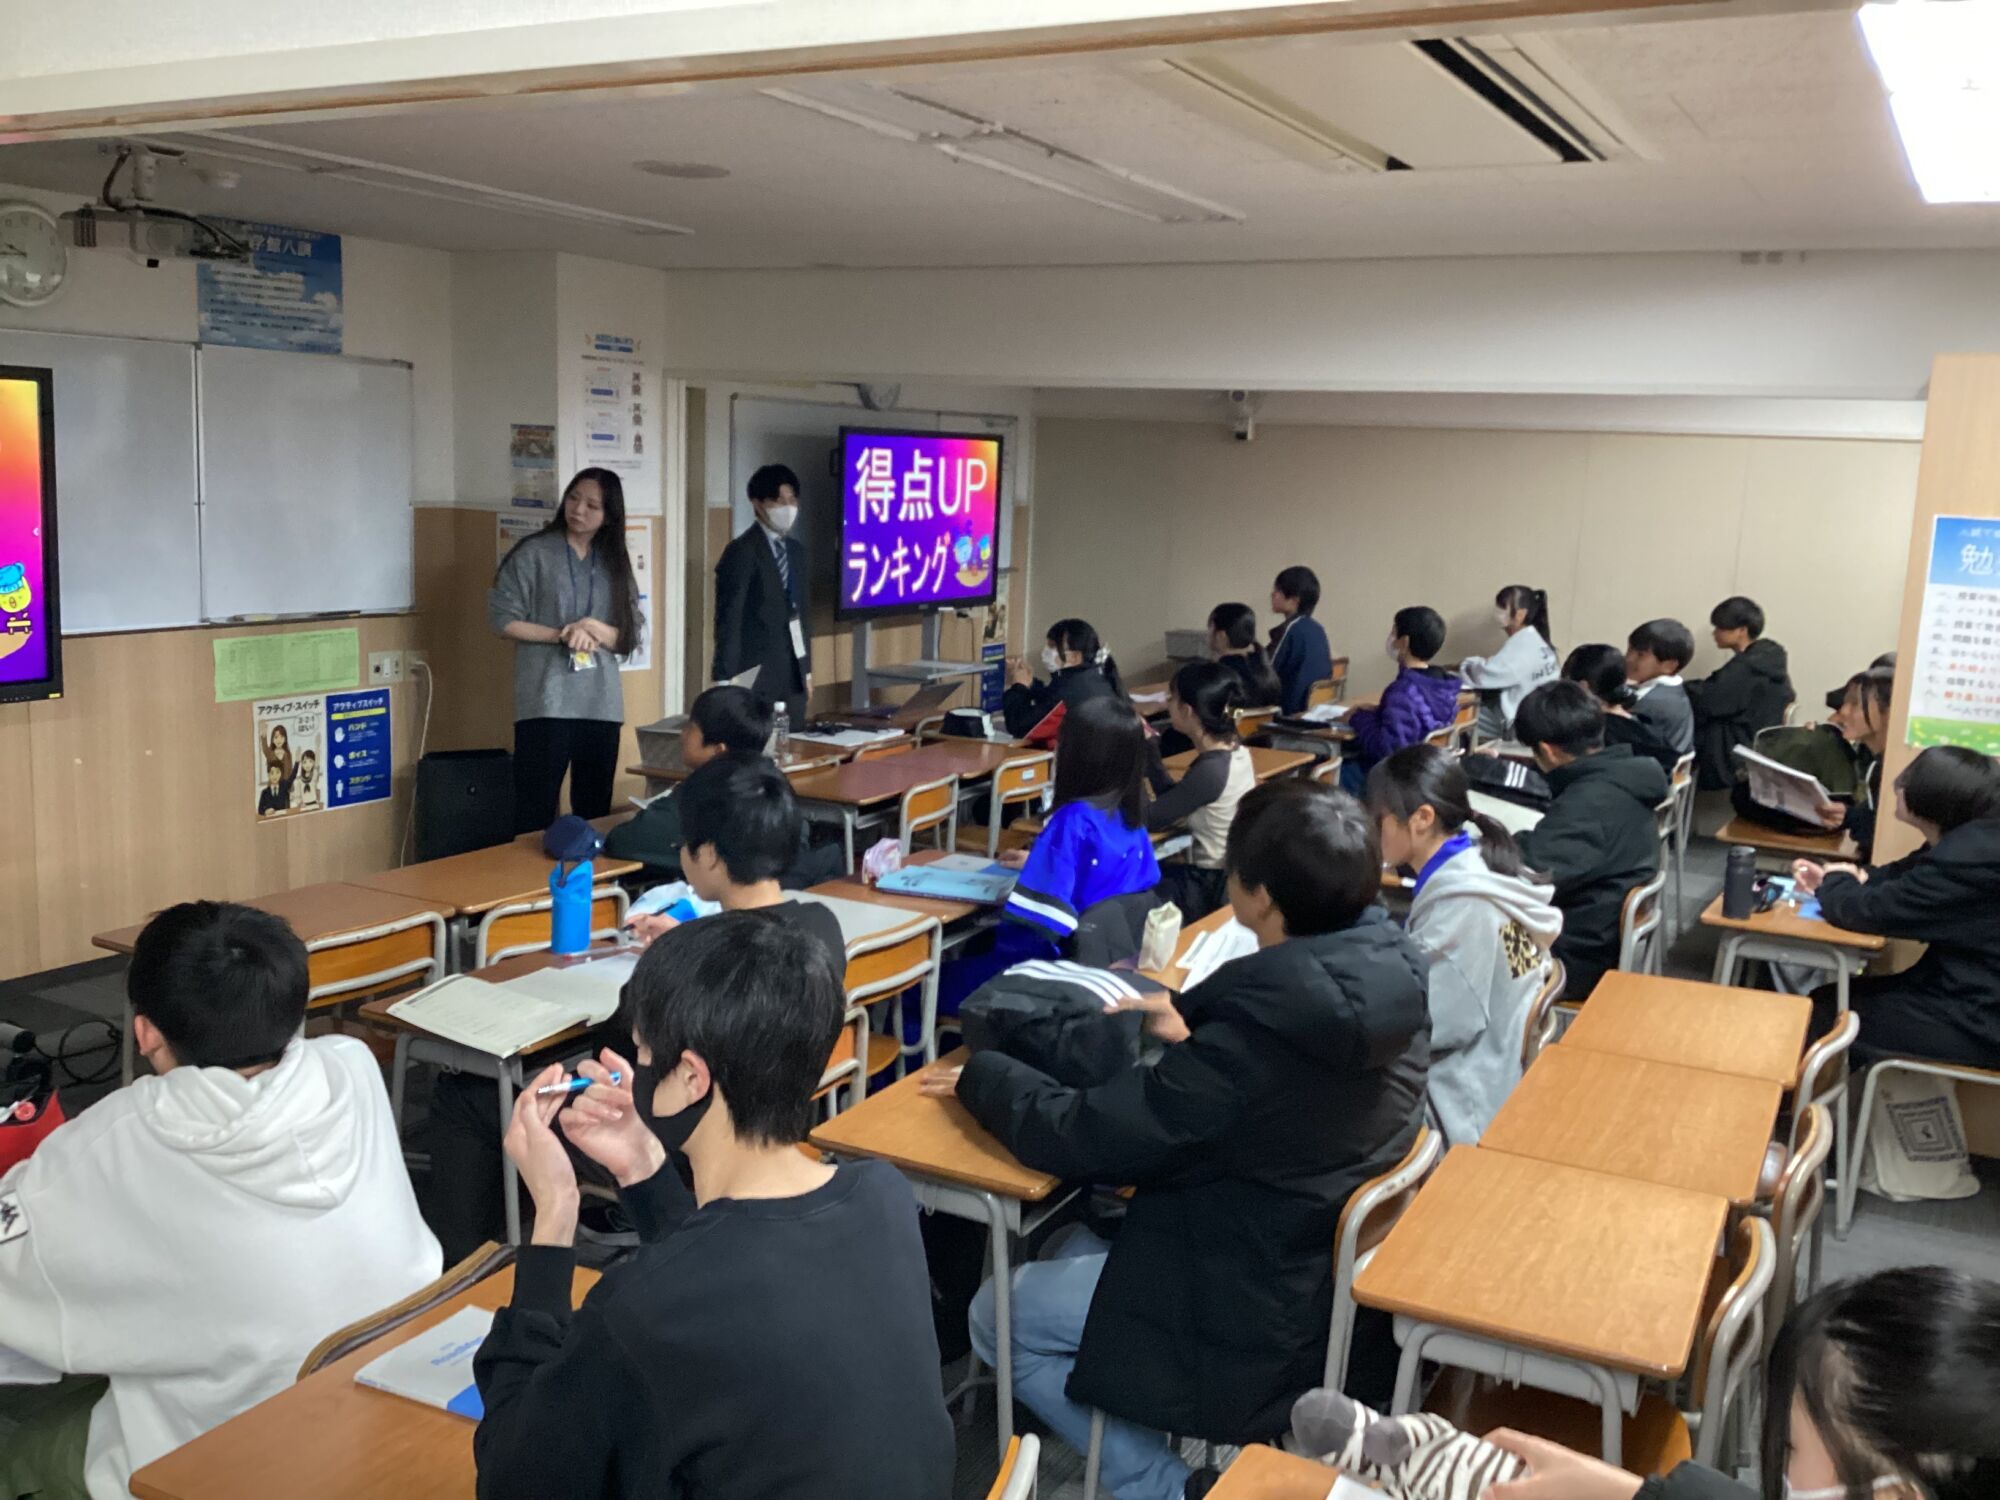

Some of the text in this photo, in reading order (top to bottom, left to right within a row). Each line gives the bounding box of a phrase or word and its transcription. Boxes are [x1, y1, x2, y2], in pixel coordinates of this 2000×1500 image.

[853, 447, 987, 524] 得点UP
[848, 531, 950, 602] ランキング
[1958, 543, 2000, 576] 勉
